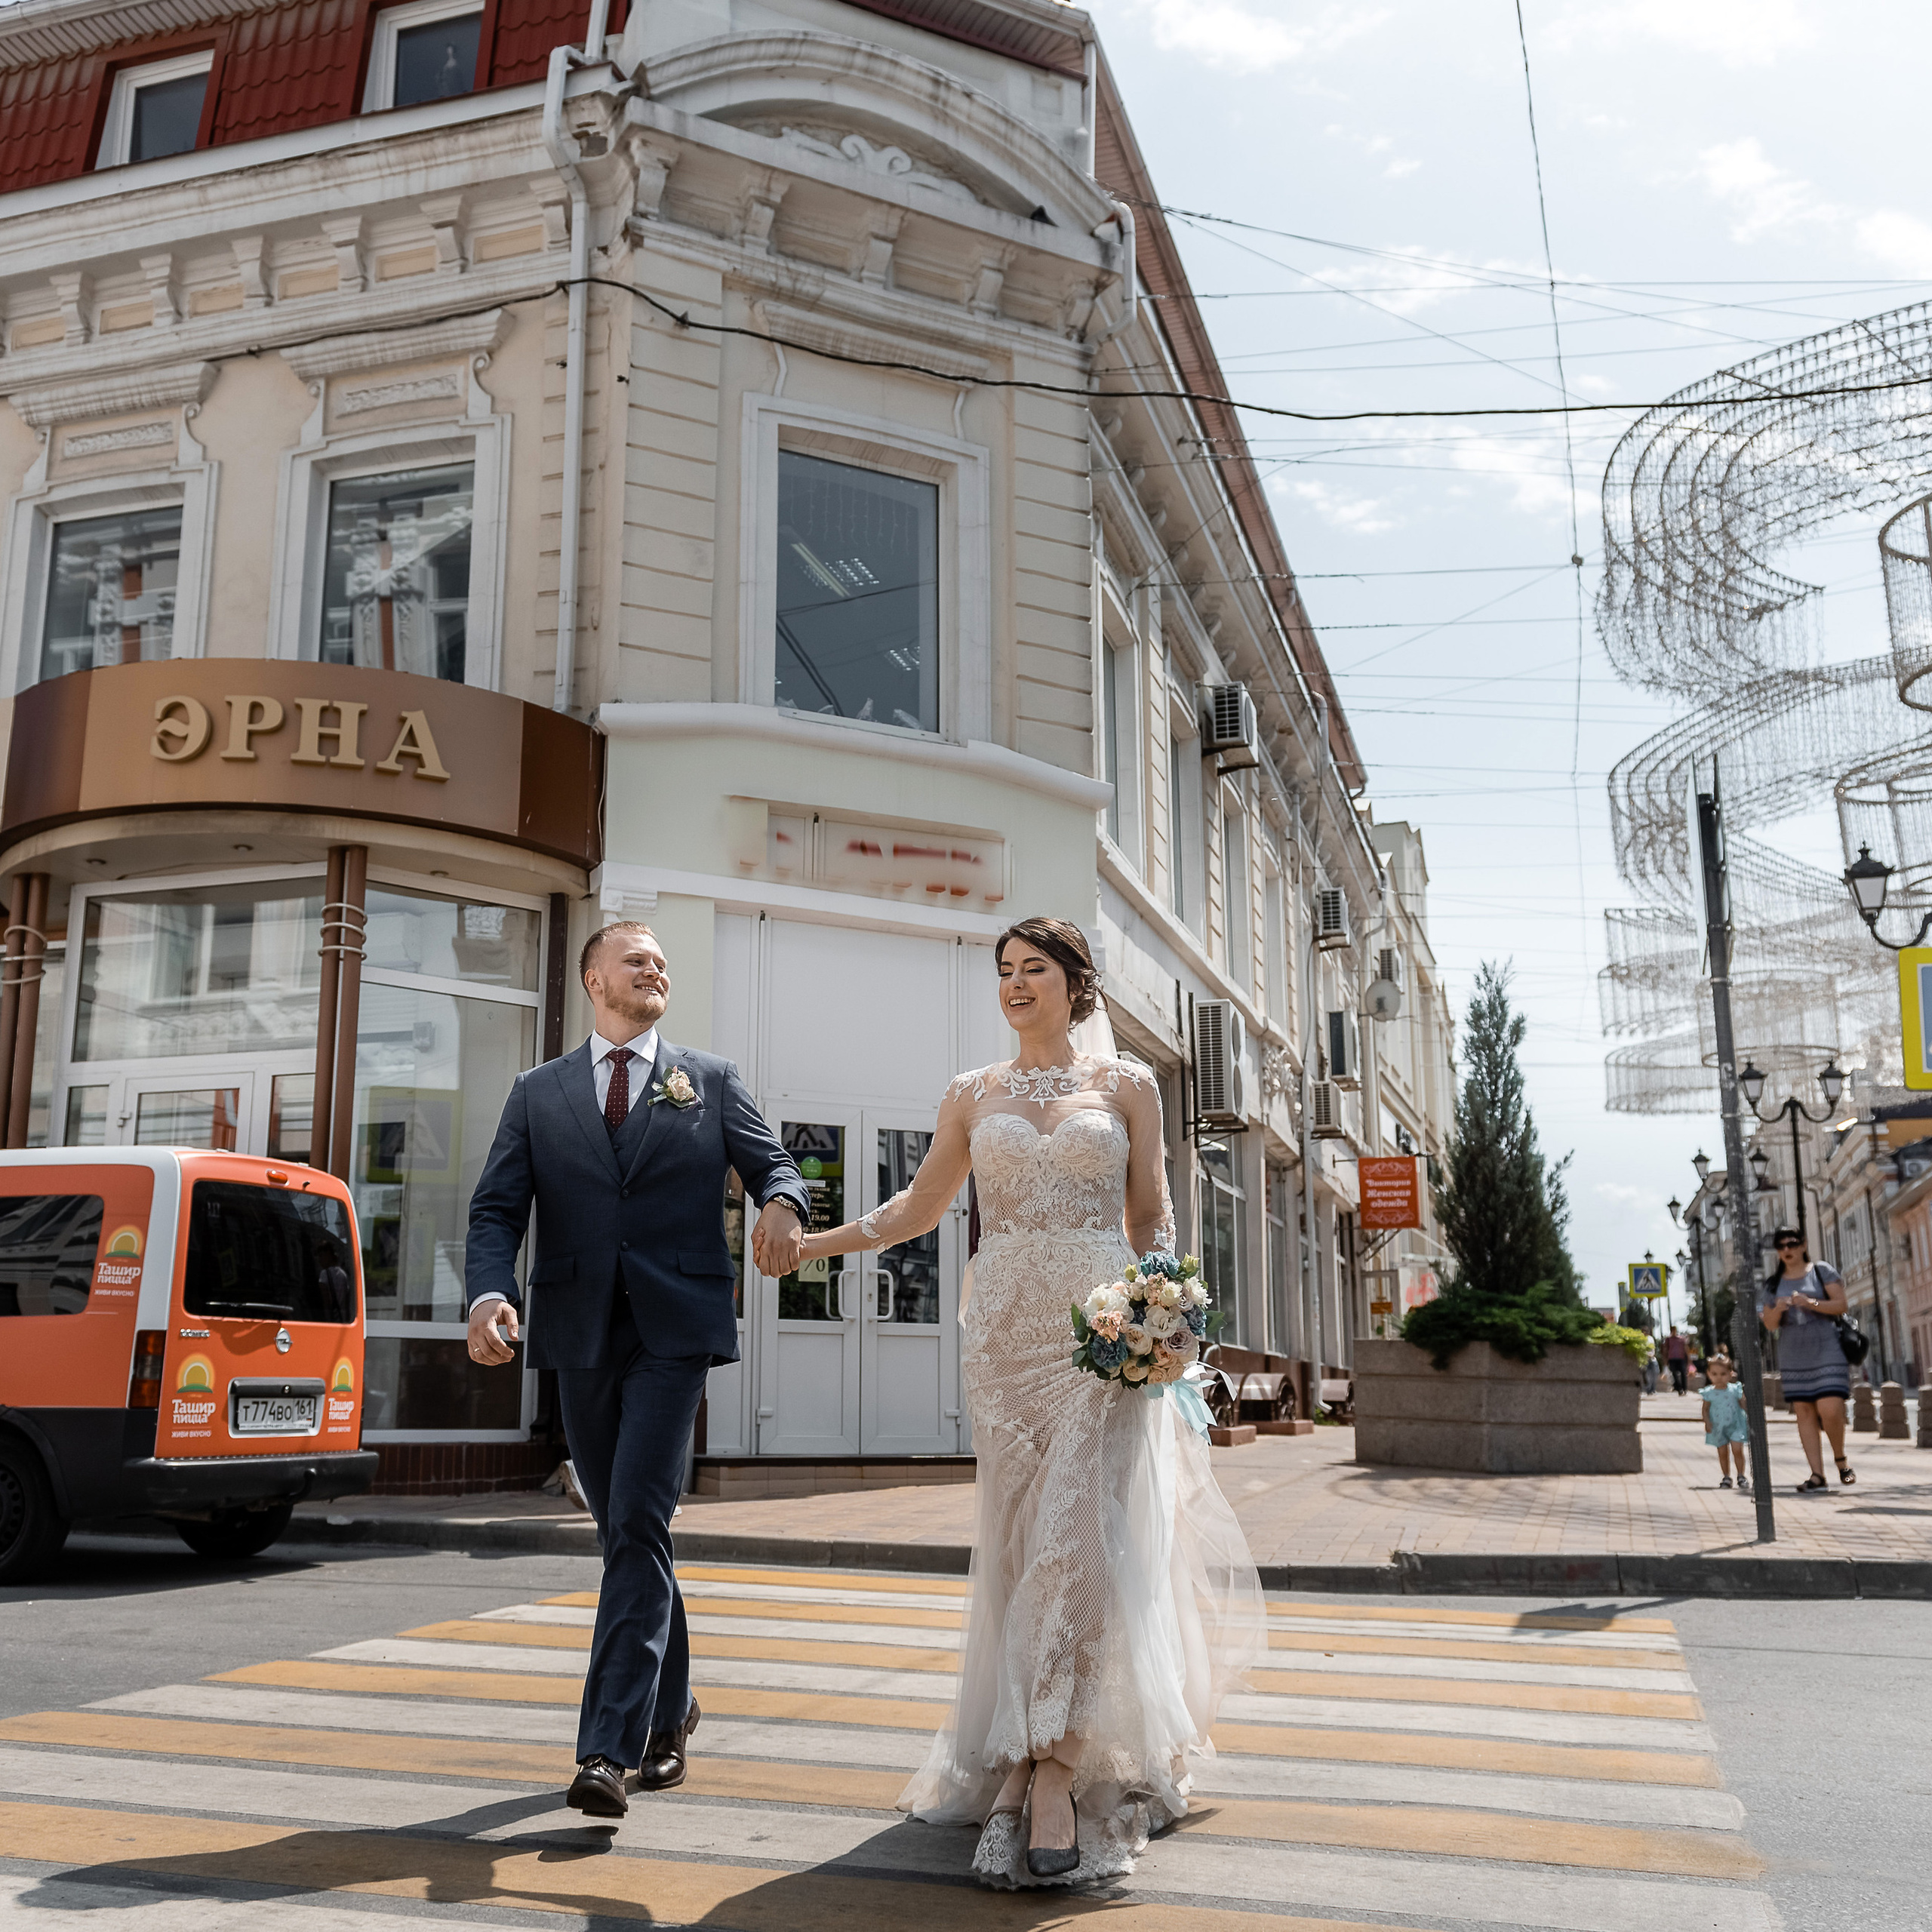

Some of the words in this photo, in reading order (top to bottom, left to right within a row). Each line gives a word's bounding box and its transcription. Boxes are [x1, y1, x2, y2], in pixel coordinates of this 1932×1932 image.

[152, 694, 451, 783] ЭРНА
[98, 1263, 141, 1279] Ташир
[97, 1275, 132, 1284] пицца
[172, 1399, 216, 1417] Ташир
[173, 1414, 208, 1425] пицца
